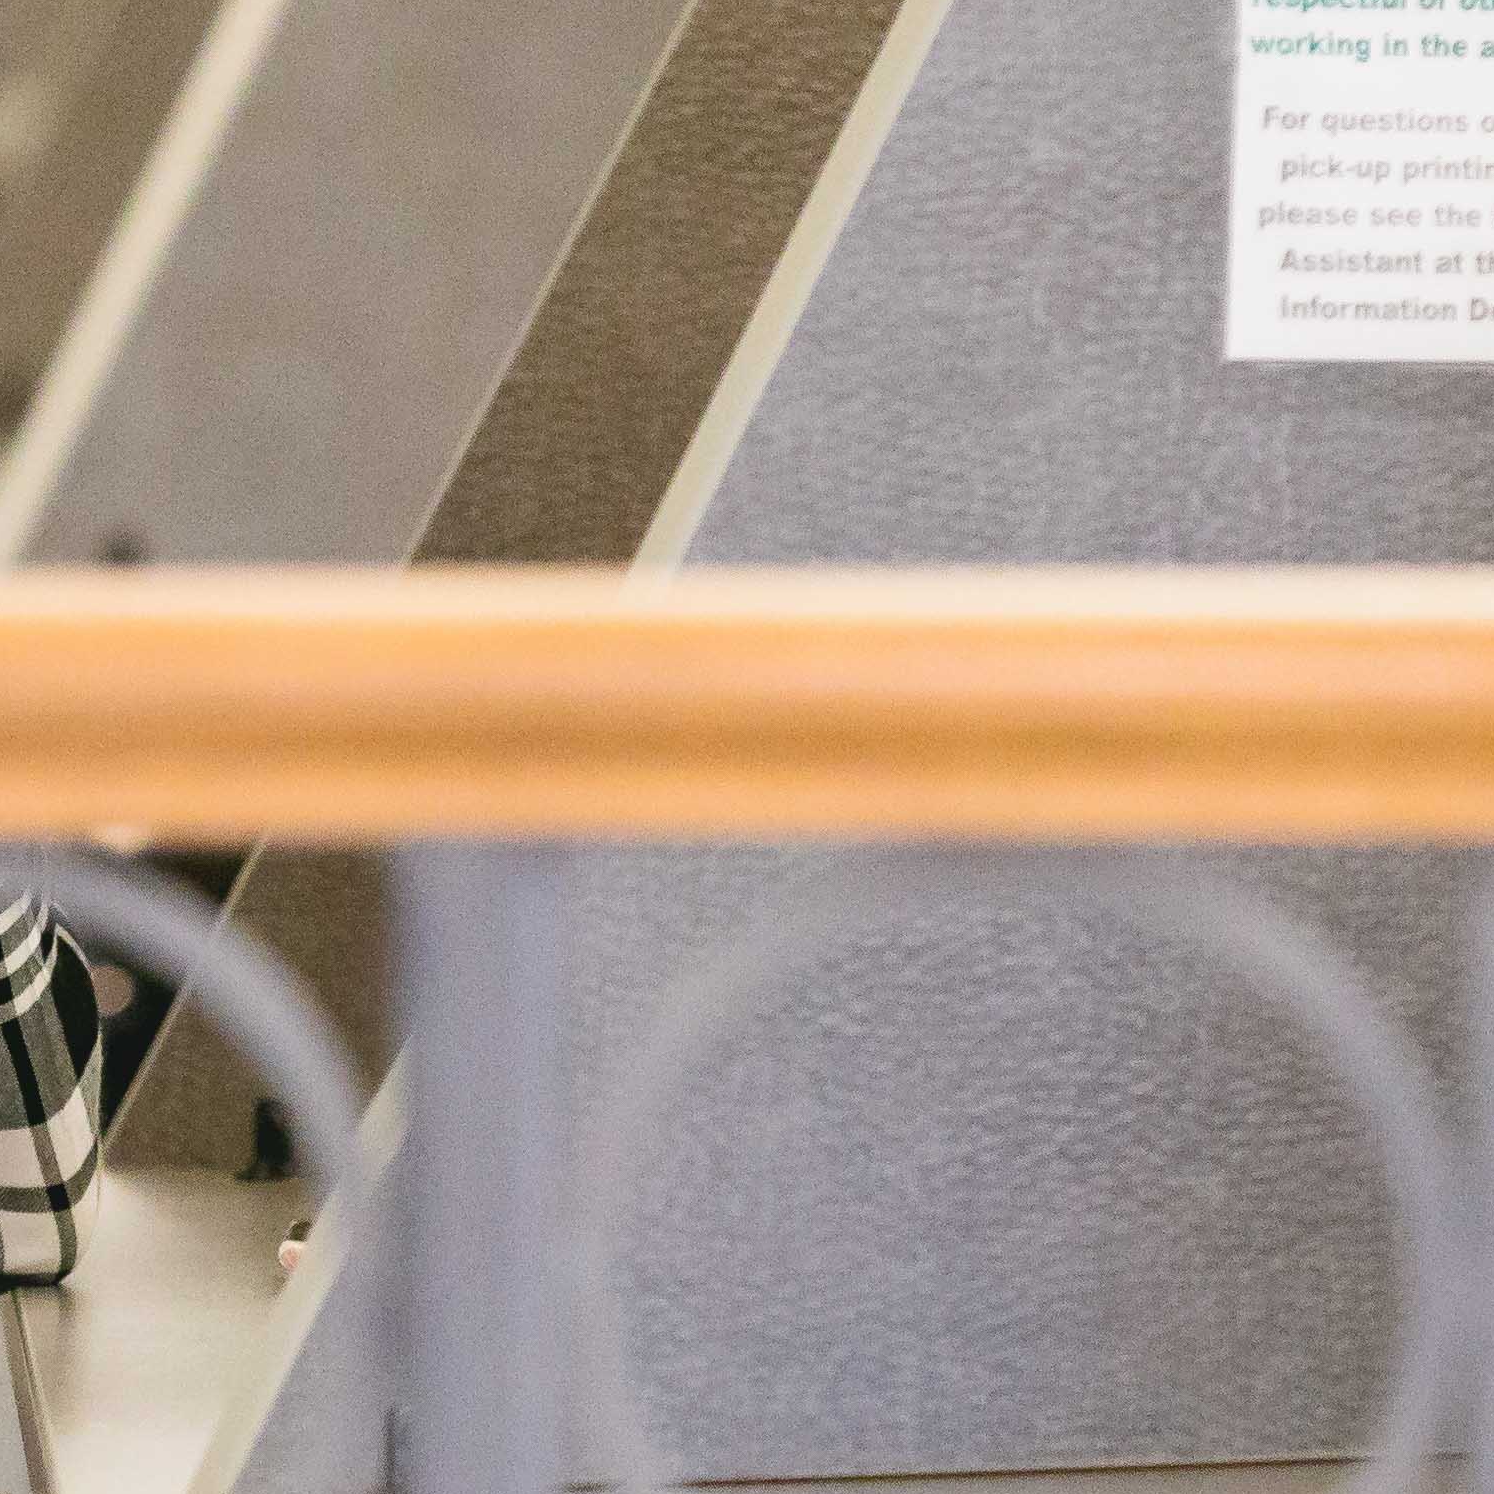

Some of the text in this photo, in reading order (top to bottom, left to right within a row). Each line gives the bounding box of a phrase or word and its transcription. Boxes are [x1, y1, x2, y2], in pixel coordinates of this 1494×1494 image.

[1249, 32, 1371, 63] working
[1383, 33, 1409, 56] in
[1420, 34, 1467, 58] the
[1262, 105, 1310, 131] For
[1320, 109, 1469, 137] questions
[1279, 154, 1391, 185] pick-up
[1257, 201, 1357, 231] please
[1370, 208, 1422, 227] see
[1433, 204, 1482, 228] the
[1278, 248, 1423, 274] Assistant
[1435, 252, 1464, 274] at
[1280, 295, 1458, 322] Information
